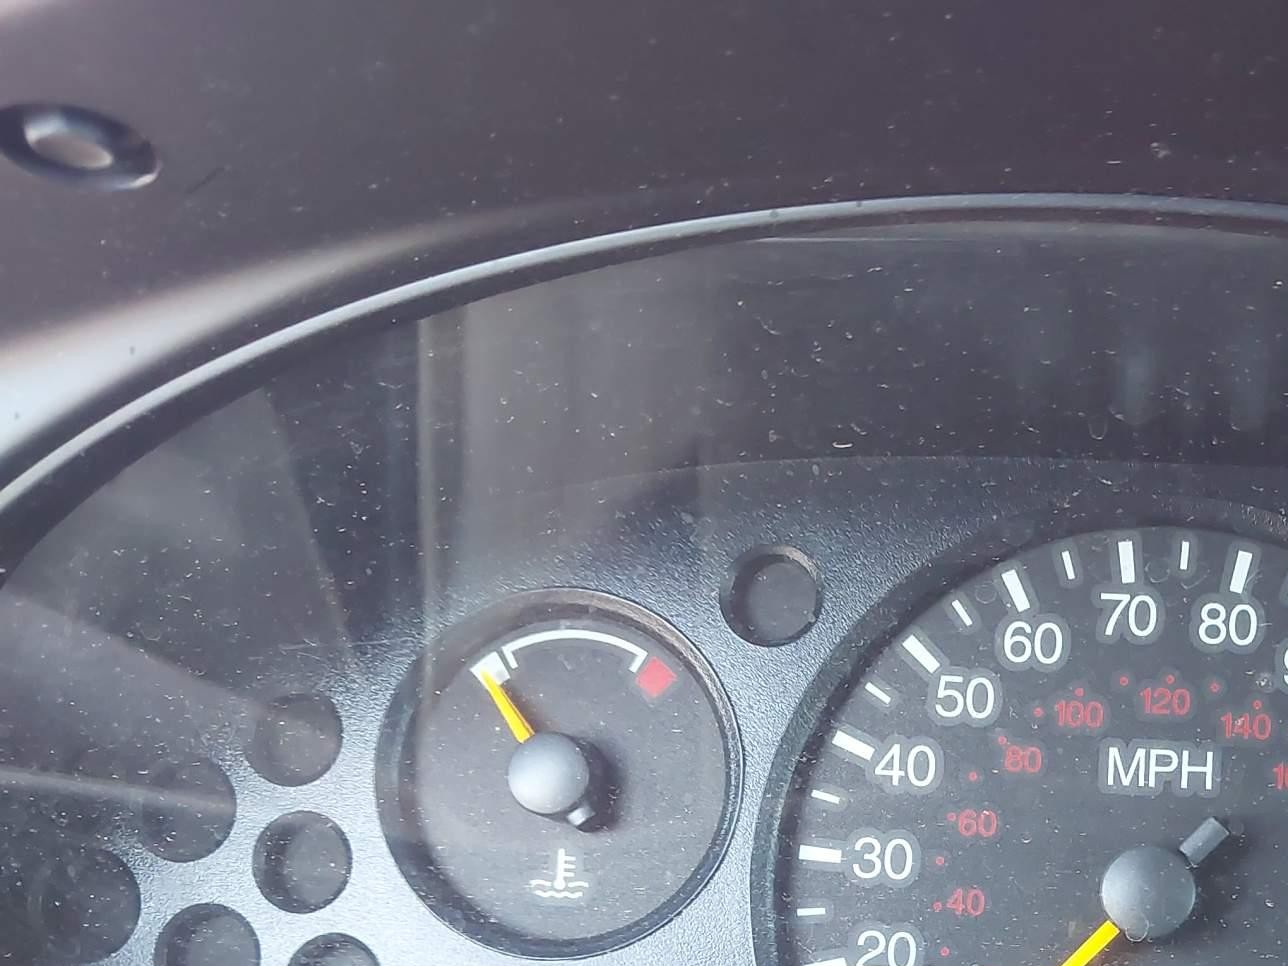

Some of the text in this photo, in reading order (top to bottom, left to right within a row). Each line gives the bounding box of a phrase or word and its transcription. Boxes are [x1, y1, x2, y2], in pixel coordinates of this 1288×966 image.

[1100, 593, 1157, 637] 70
[1199, 603, 1257, 645] 80
[1003, 621, 1063, 664] 60
[935, 675, 994, 719] 50
[1056, 700, 1104, 727] 100
[1139, 688, 1190, 715] 120
[1220, 712, 1271, 740] 140
[874, 743, 935, 786] 40
[1004, 746, 1042, 773] 80
[1107, 747, 1214, 790] MPH
[957, 810, 998, 838] 60
[852, 837, 913, 880] 30
[947, 889, 985, 916] 40
